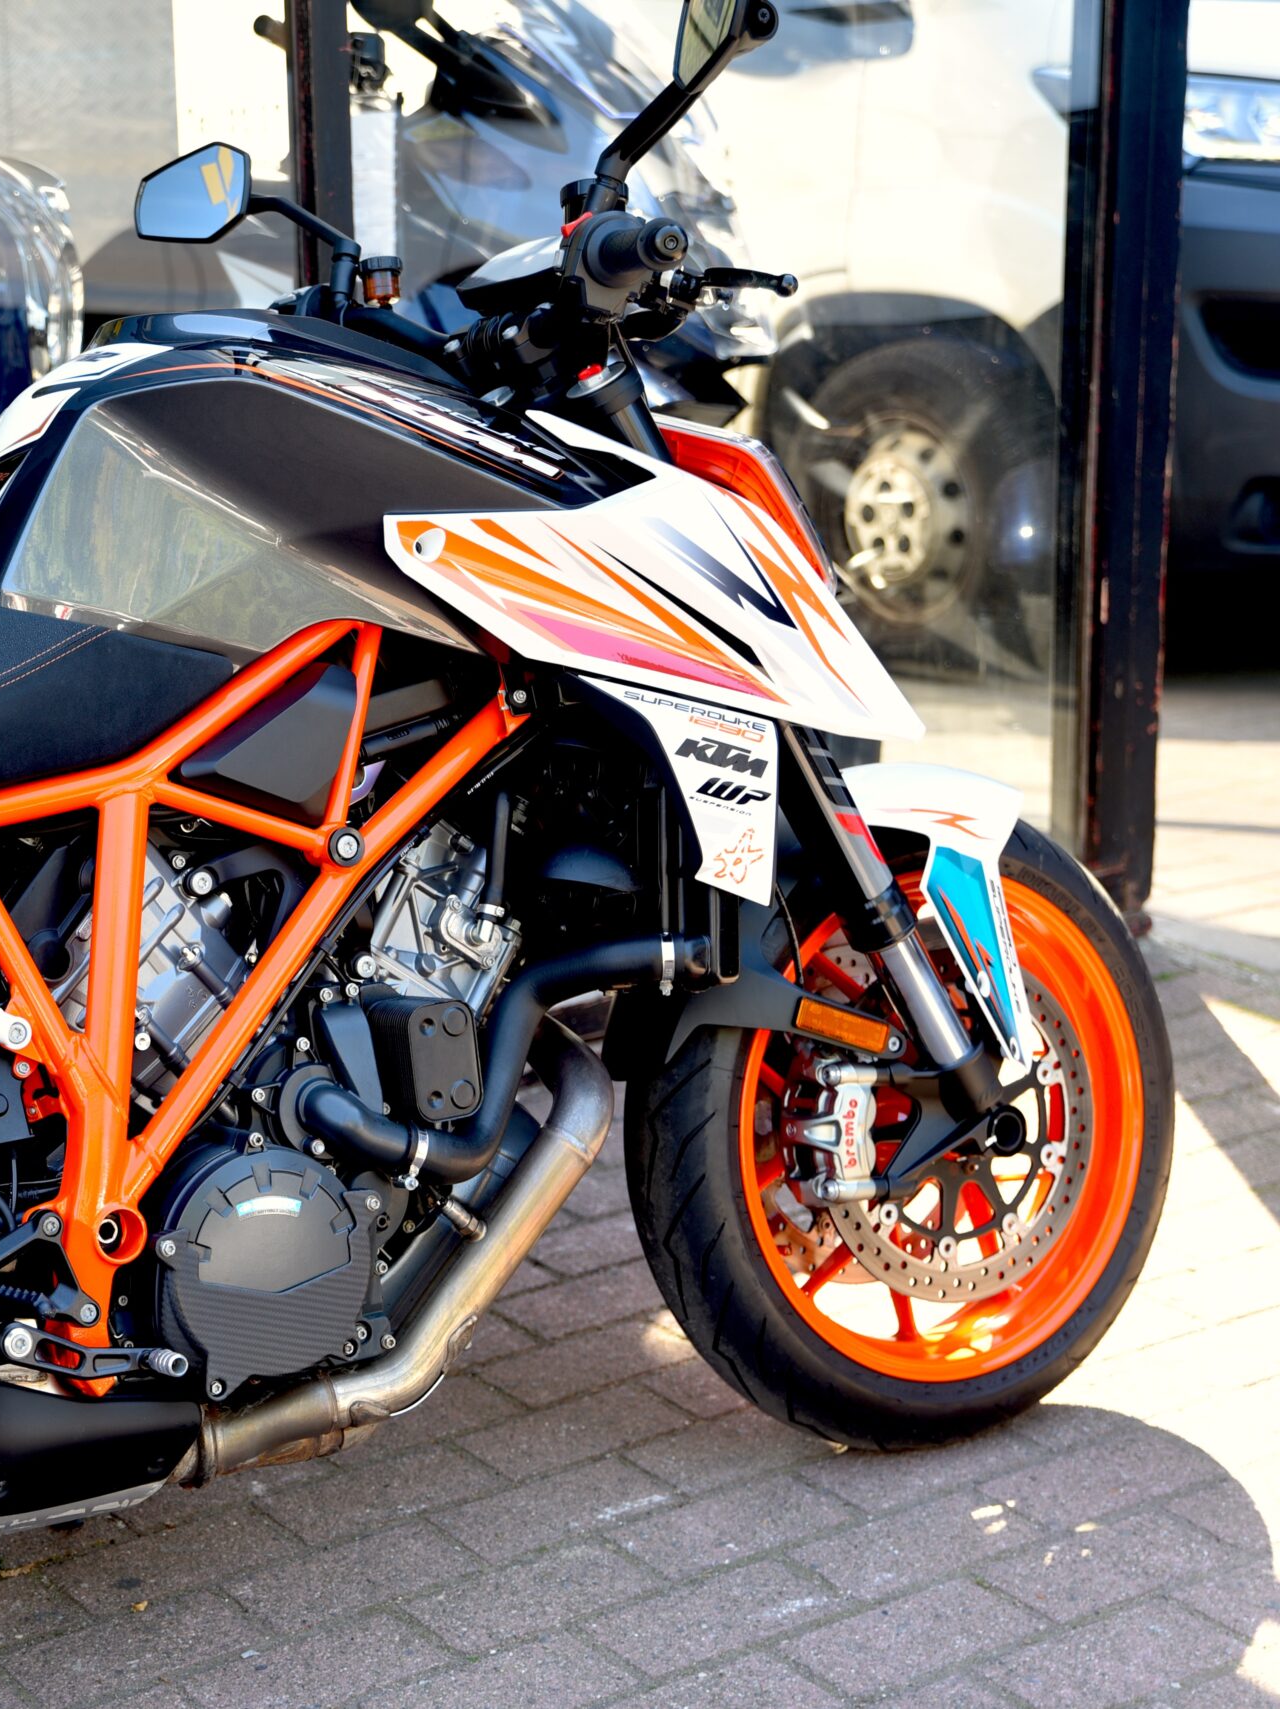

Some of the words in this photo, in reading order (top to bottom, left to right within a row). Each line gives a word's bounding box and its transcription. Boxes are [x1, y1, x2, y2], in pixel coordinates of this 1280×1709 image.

[623, 690, 767, 733] SUPERDUKE
[688, 715, 765, 744] 1290
[674, 736, 769, 779] KTM
[695, 777, 772, 805] WP
[842, 1098, 858, 1169] brembo
